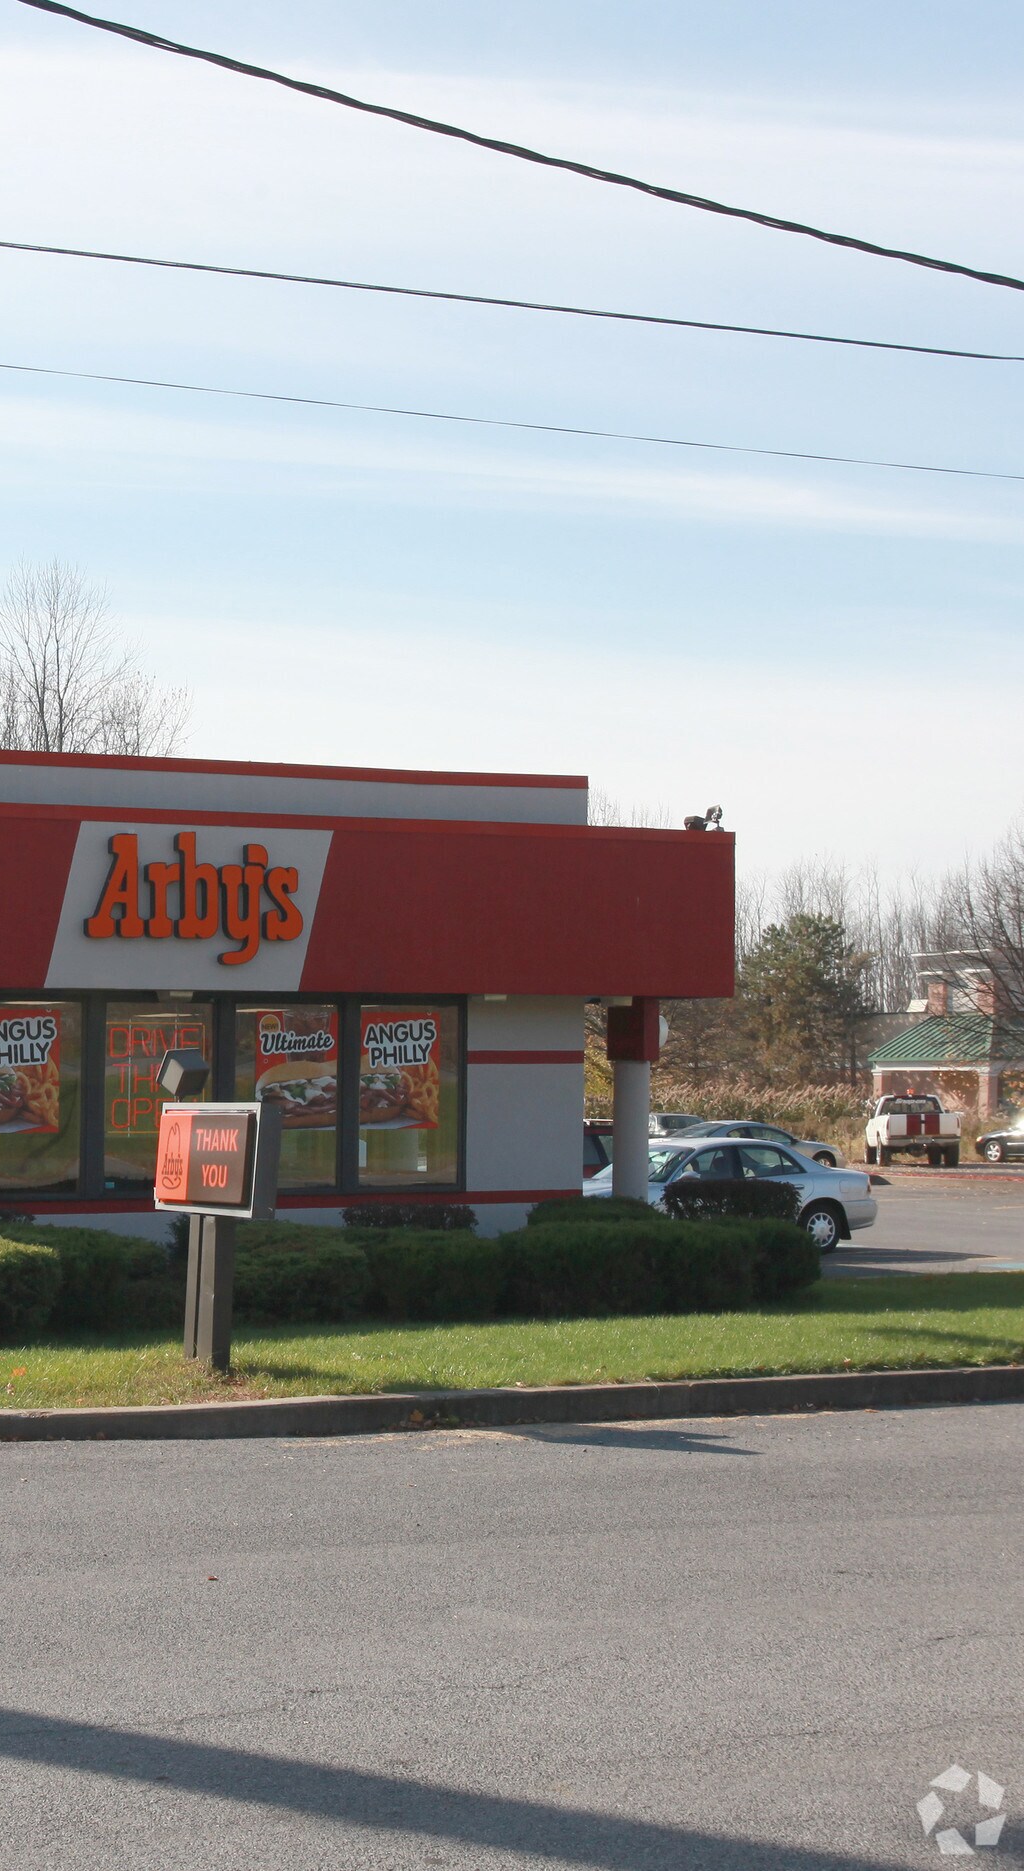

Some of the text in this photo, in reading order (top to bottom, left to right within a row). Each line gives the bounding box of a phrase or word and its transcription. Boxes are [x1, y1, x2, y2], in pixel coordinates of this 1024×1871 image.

[84, 831, 304, 965] Arby's
[109, 1027, 200, 1058] DRIVE
[260, 1031, 334, 1053] Ultimate
[365, 1021, 436, 1046] ANGUS
[370, 1042, 431, 1067] PHILLY
[111, 1097, 184, 1129] OPE
[196, 1129, 239, 1152] THANK
[201, 1164, 228, 1188] YOU
